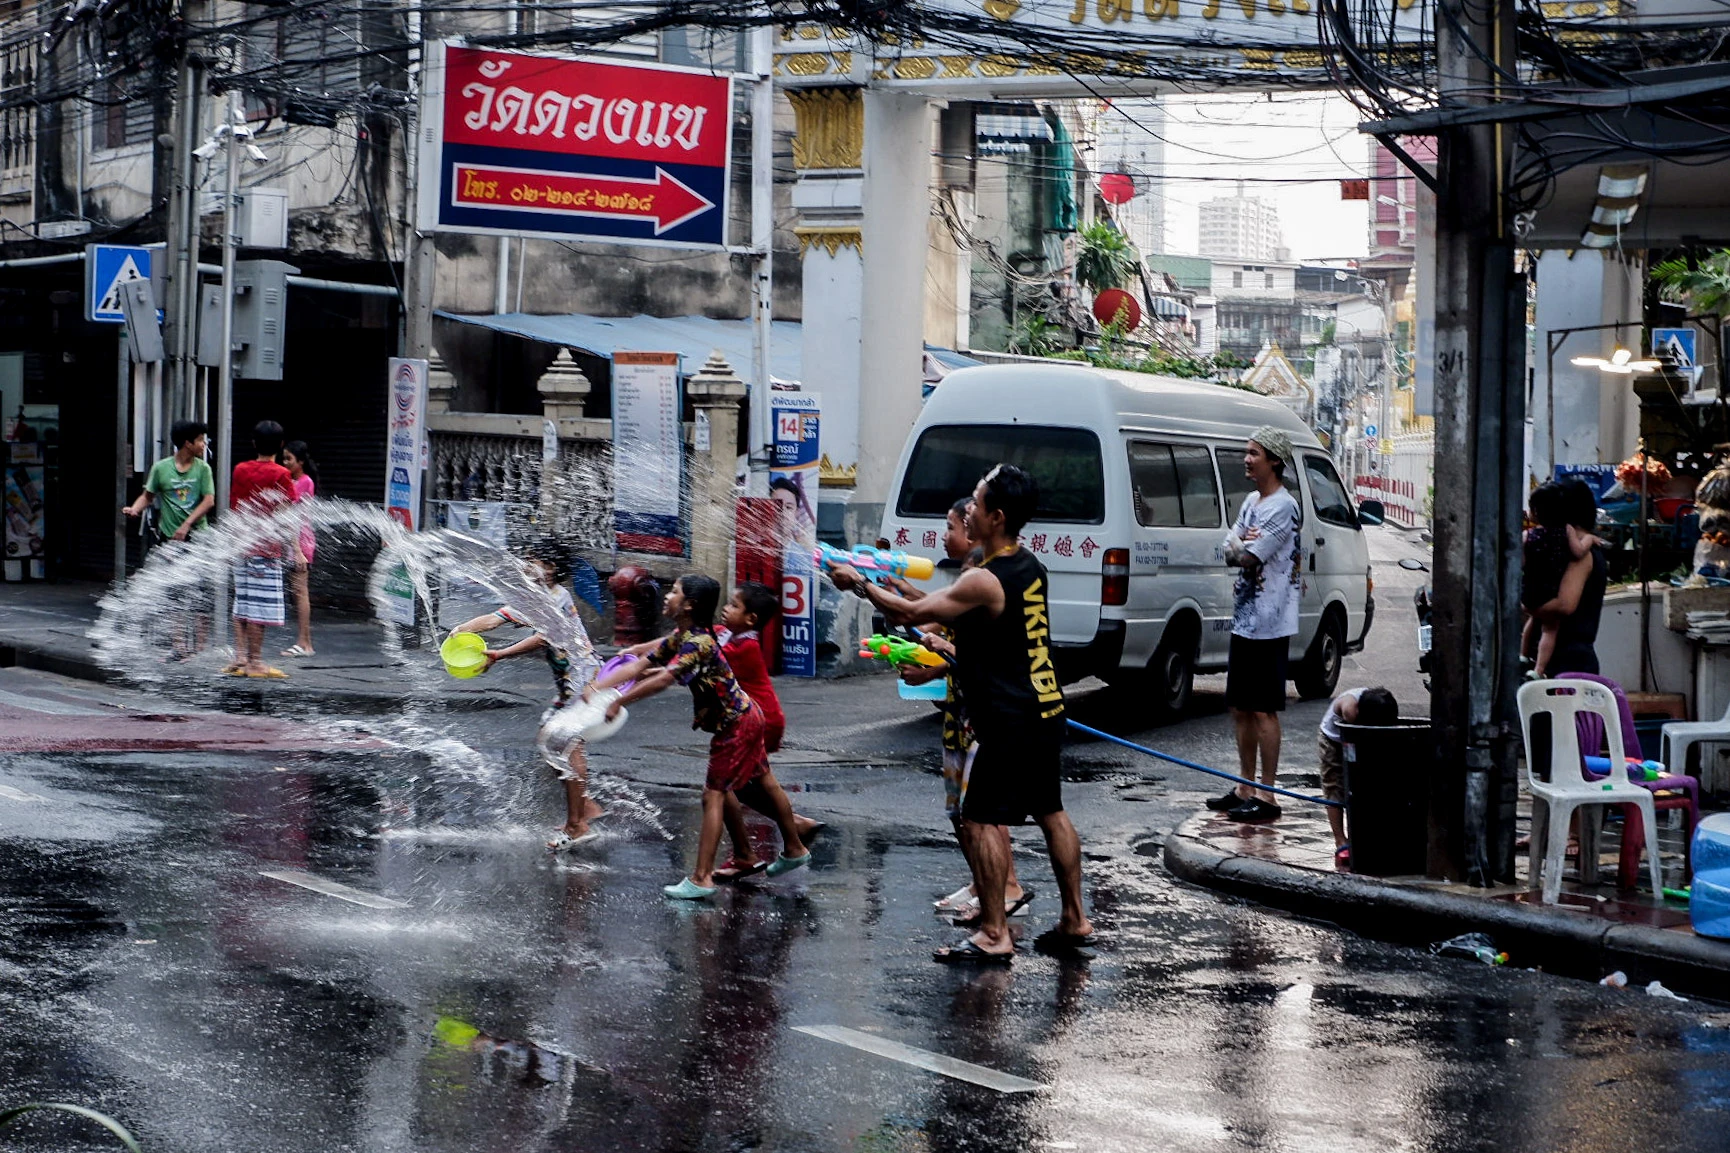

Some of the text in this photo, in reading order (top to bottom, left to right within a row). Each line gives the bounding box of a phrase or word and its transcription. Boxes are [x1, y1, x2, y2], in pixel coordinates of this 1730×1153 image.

[461, 59, 708, 151] วัดดวงแข
[1438, 349, 1464, 374] 3/1
[780, 418, 798, 435] 14
[781, 576, 805, 615] 3
